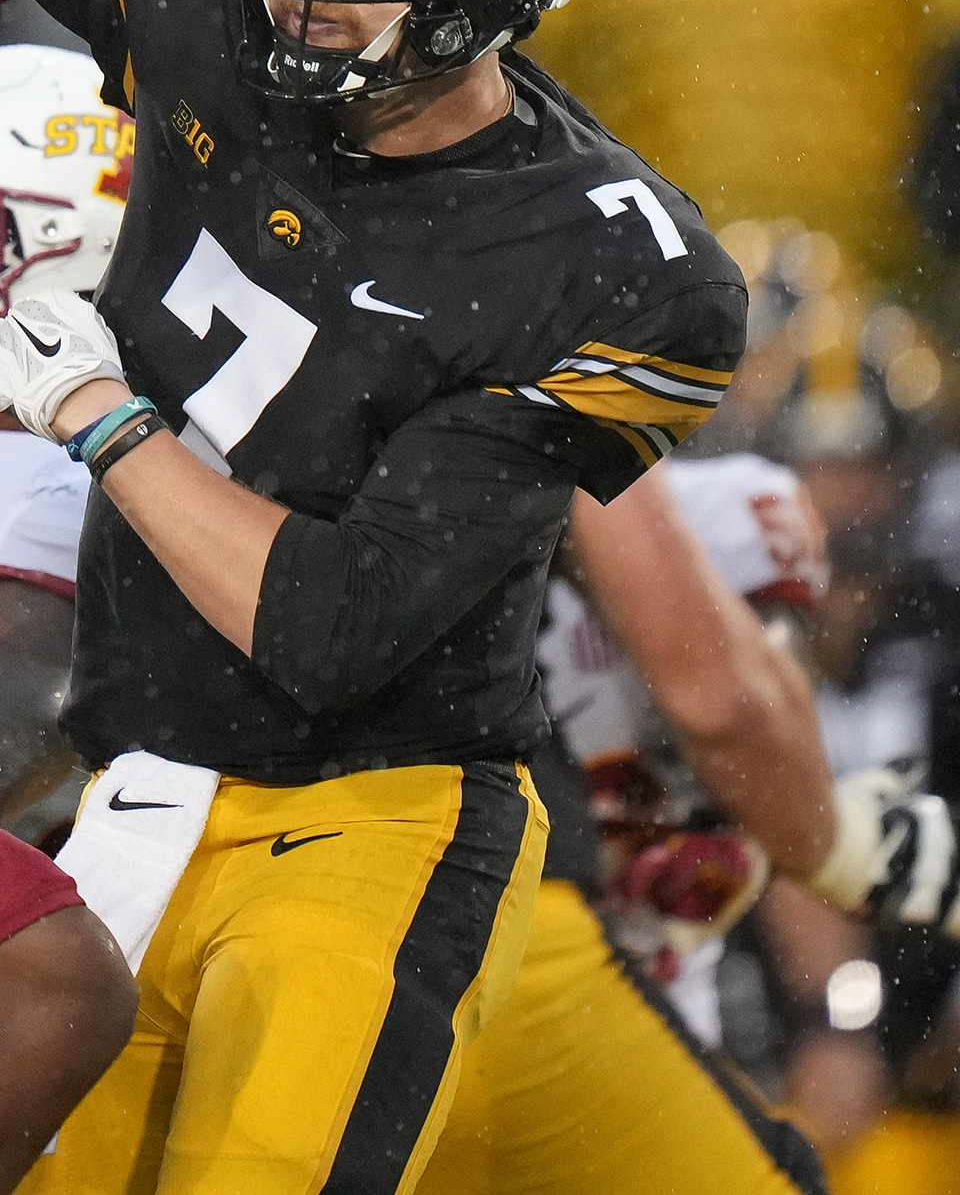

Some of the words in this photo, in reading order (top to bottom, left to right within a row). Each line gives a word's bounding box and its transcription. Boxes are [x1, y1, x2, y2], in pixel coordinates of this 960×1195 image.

[43, 114, 137, 158] STA
[586, 178, 689, 261] 7
[161, 227, 318, 477] 7
